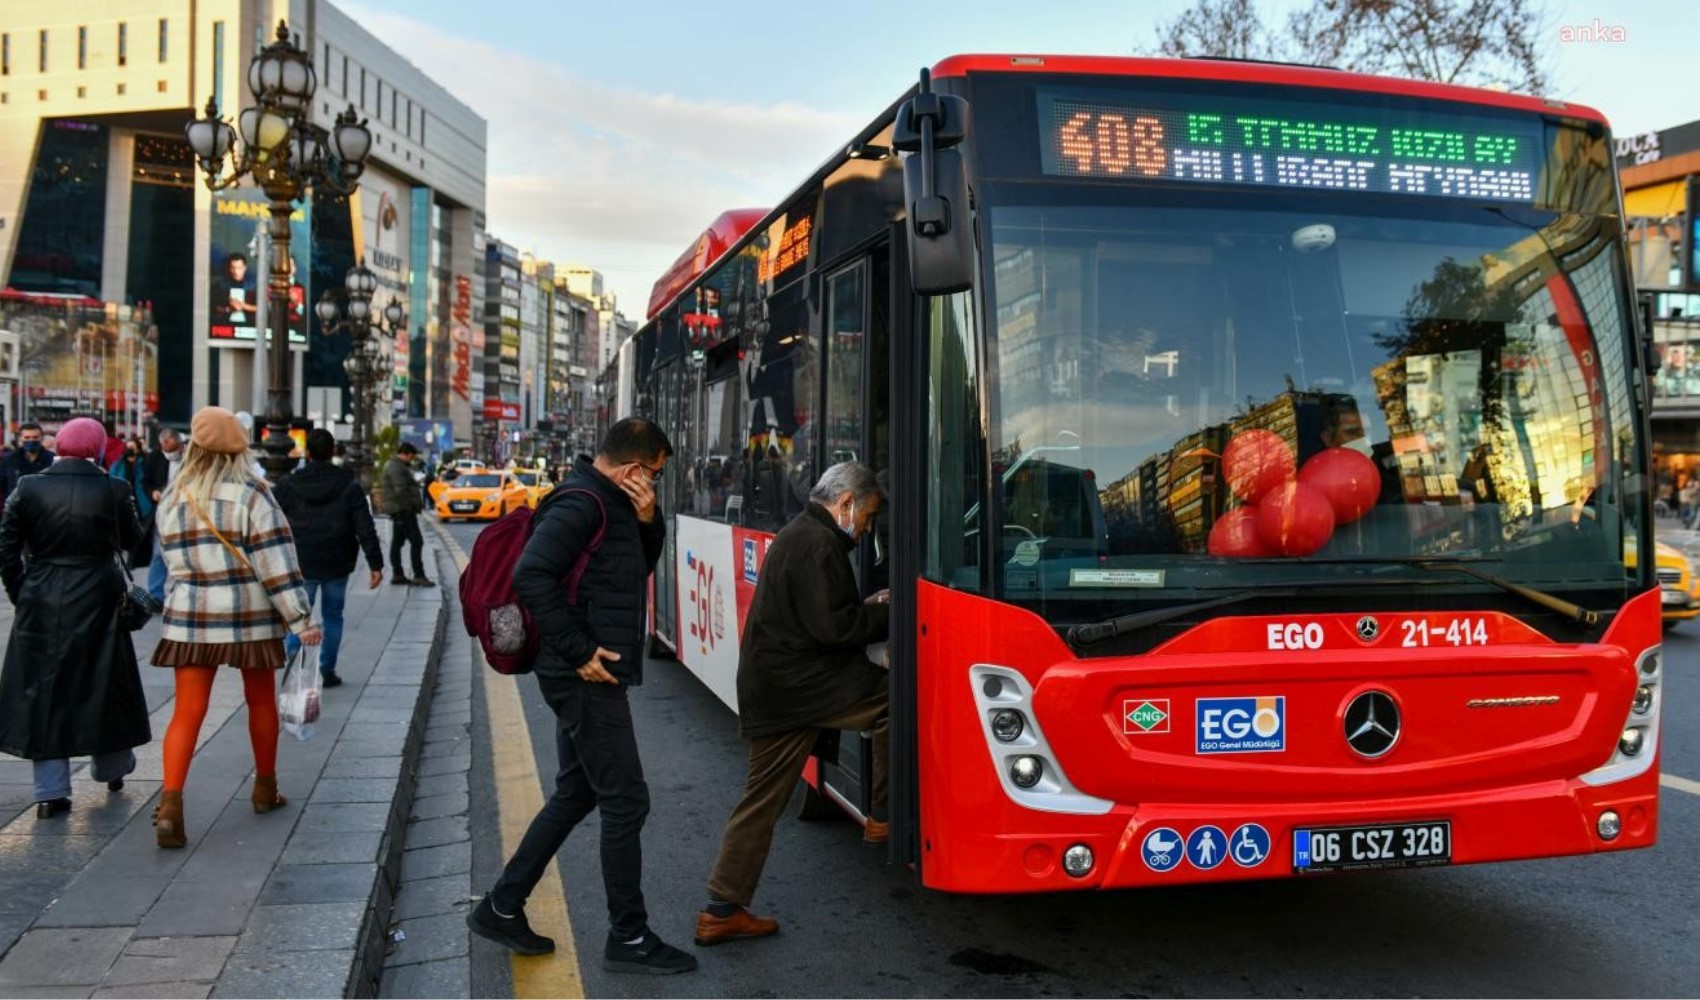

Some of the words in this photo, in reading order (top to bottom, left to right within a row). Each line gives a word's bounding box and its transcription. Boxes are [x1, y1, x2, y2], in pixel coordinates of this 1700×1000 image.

[1061, 112, 1166, 175] 408
[1615, 130, 1660, 157] OCA
[1267, 621, 1324, 650] EGO
[1401, 617, 1488, 648] 21-414
[1133, 710, 1162, 723] CNG
[1201, 708, 1280, 740] EGO
[1200, 741, 1218, 750] EGO
[1219, 741, 1241, 750] Genel
[1297, 851, 1309, 861] TR
[1311, 833, 1341, 863] 06
[1352, 829, 1395, 861] CSZ
[1402, 826, 1444, 857] 328
